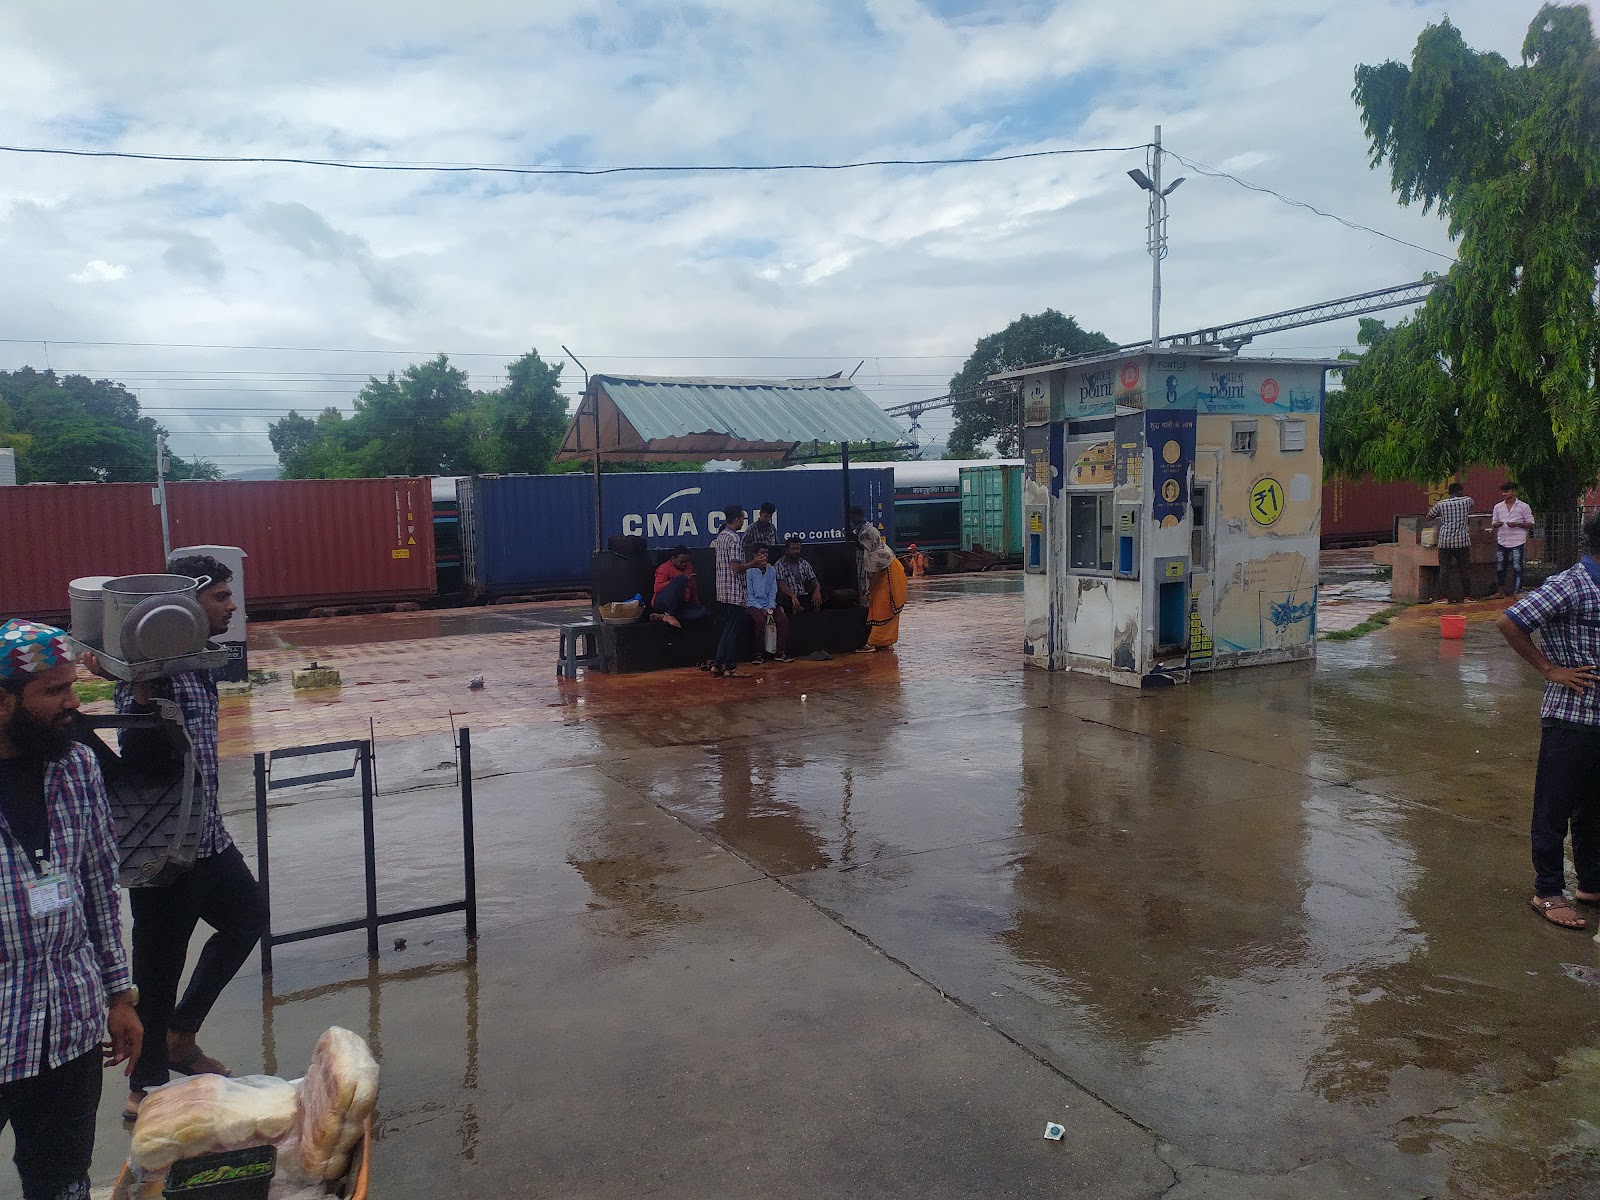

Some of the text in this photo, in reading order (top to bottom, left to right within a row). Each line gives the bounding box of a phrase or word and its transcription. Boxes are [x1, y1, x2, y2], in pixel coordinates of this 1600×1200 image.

[1079, 380, 1114, 403] point
[1208, 382, 1245, 403] point
[622, 511, 699, 538] CMA
[784, 530, 806, 541] eco
